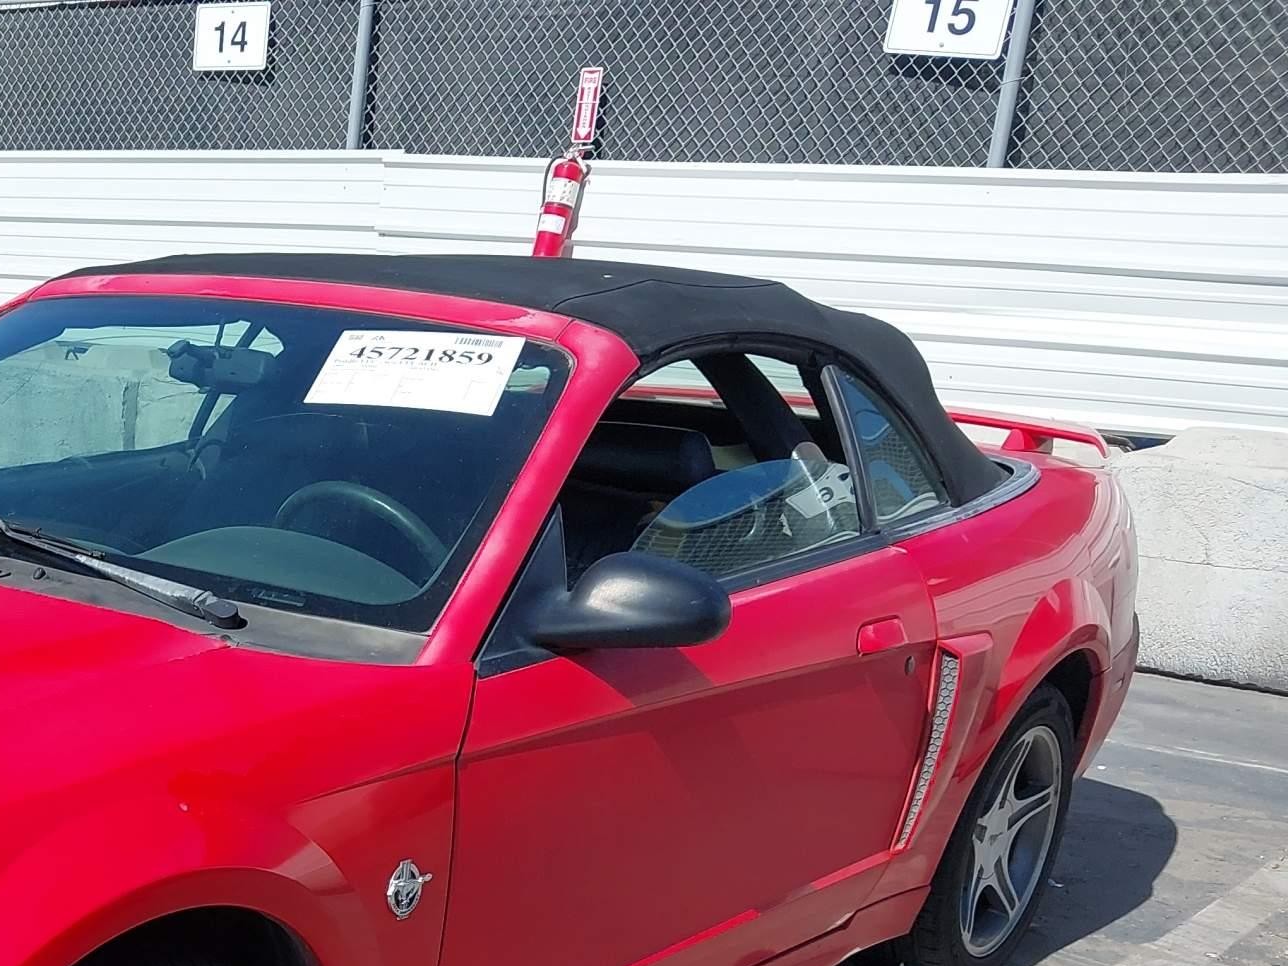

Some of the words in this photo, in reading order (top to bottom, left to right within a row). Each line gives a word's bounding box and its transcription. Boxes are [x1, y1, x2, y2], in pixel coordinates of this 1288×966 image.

[925, 0, 976, 36] 15
[214, 20, 248, 53] 14
[349, 345, 493, 366] 45721859
